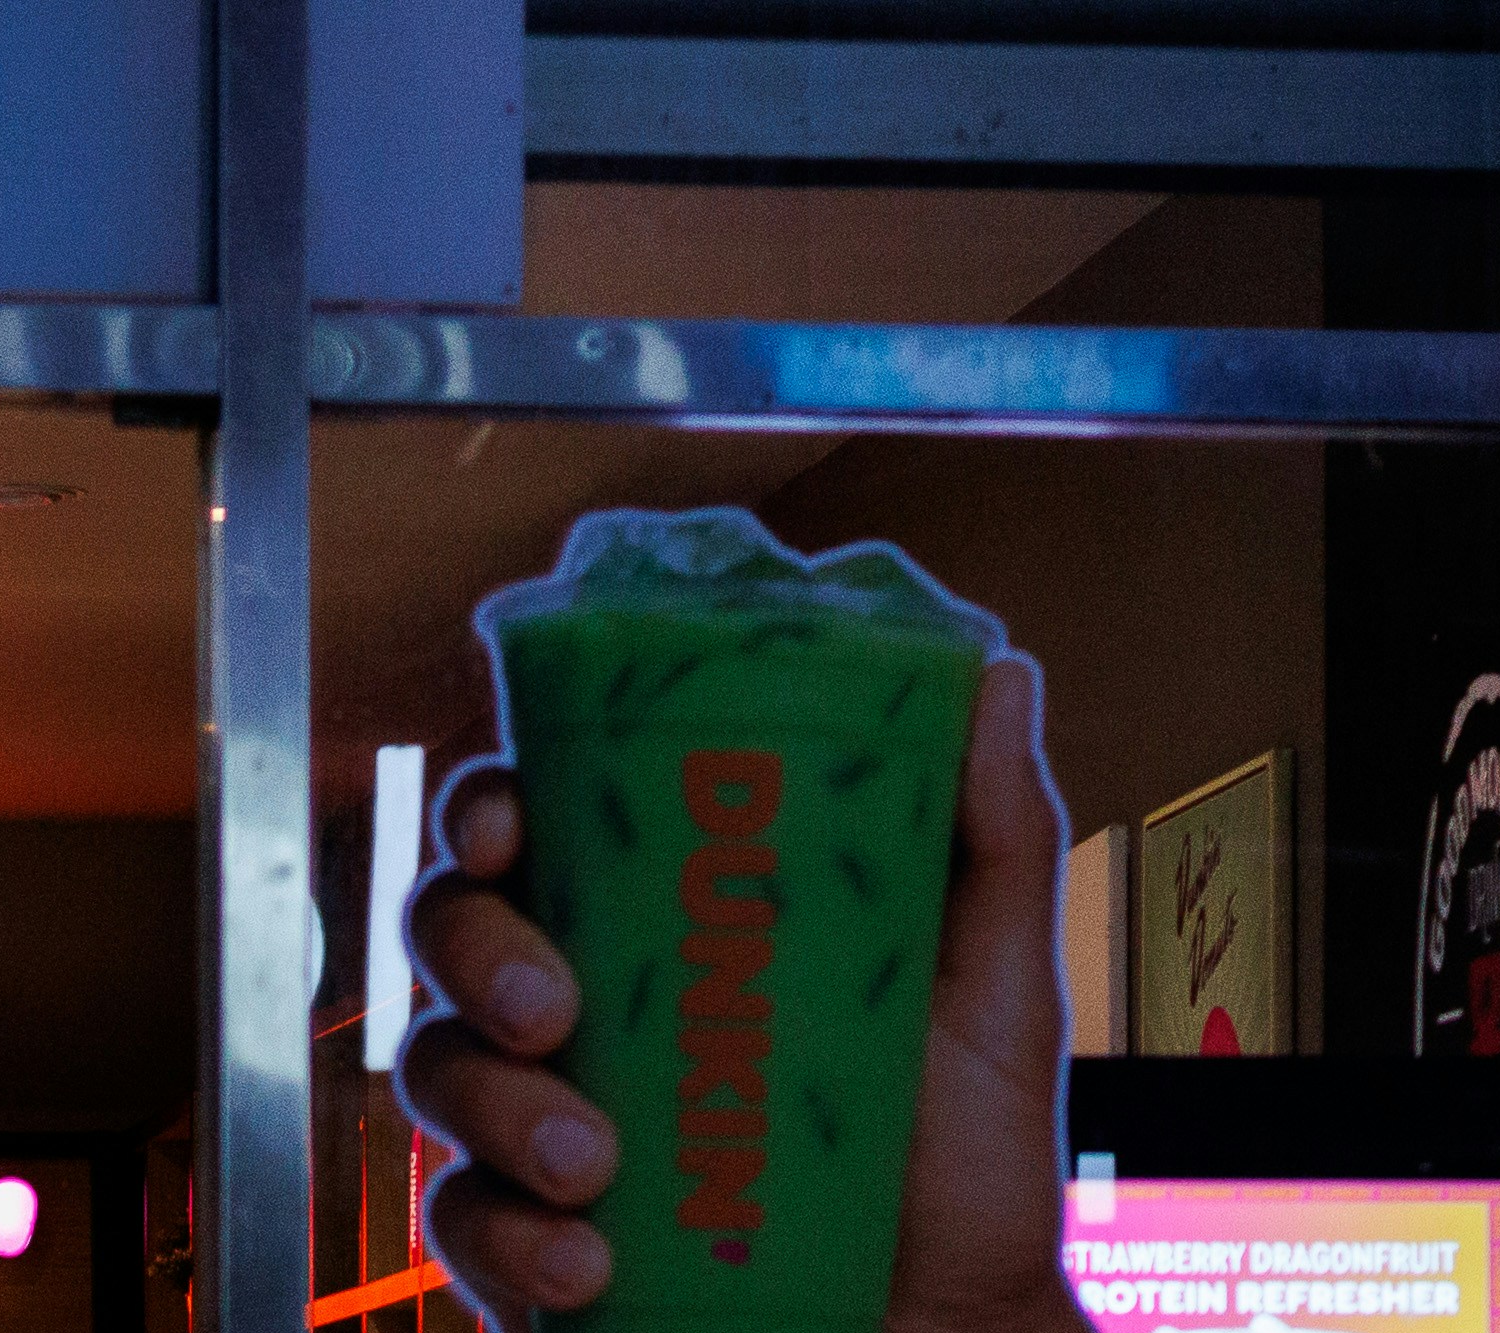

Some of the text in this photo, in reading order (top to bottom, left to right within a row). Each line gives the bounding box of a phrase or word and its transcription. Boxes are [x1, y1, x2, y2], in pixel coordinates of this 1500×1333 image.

[674, 747, 784, 1266] DUNKIN'
[1248, 1240, 1461, 1275] DRAGONFRUIT
[1078, 1281, 1460, 1316] ROTEIN REFRESHER
